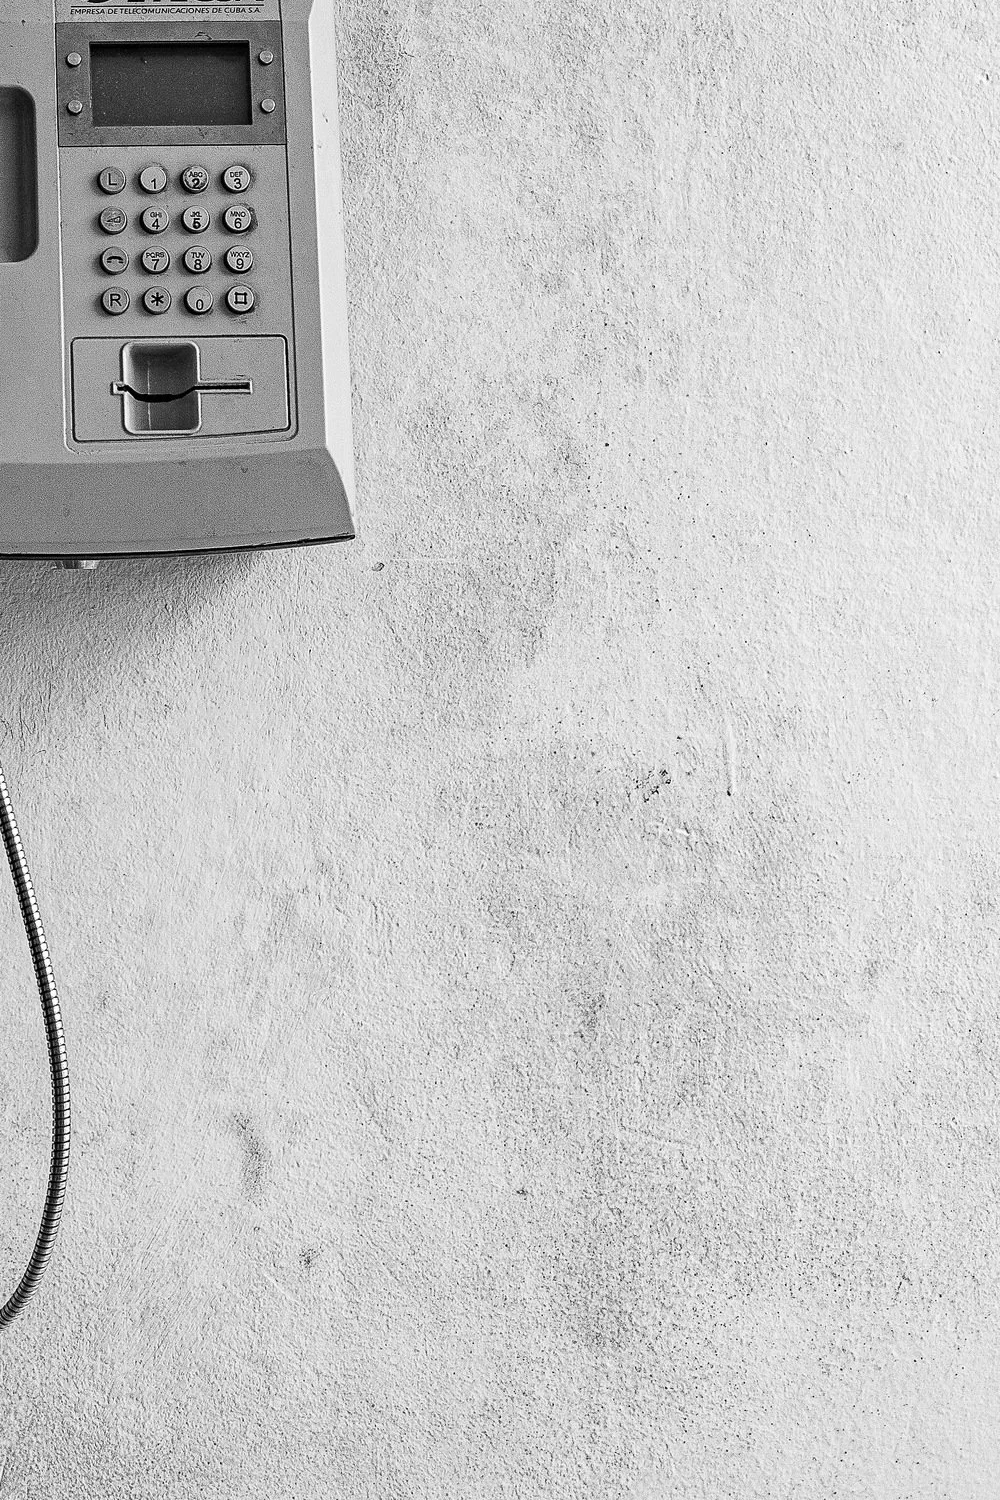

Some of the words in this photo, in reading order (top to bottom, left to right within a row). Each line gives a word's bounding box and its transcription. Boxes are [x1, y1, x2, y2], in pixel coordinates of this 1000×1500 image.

[107, 172, 118, 186] L
[150, 177, 157, 190] 1
[191, 177, 201, 190] 2
[233, 177, 242, 190] 3
[151, 218, 160, 230] 4
[192, 217, 201, 230] 5
[234, 217, 242, 229] 6
[190, 251, 205, 259] TUV
[151, 258, 160, 271] 7
[193, 258, 202, 271] 8
[235, 257, 244, 270] 9
[109, 293, 122, 307] R
[195, 298, 204, 311] 0
